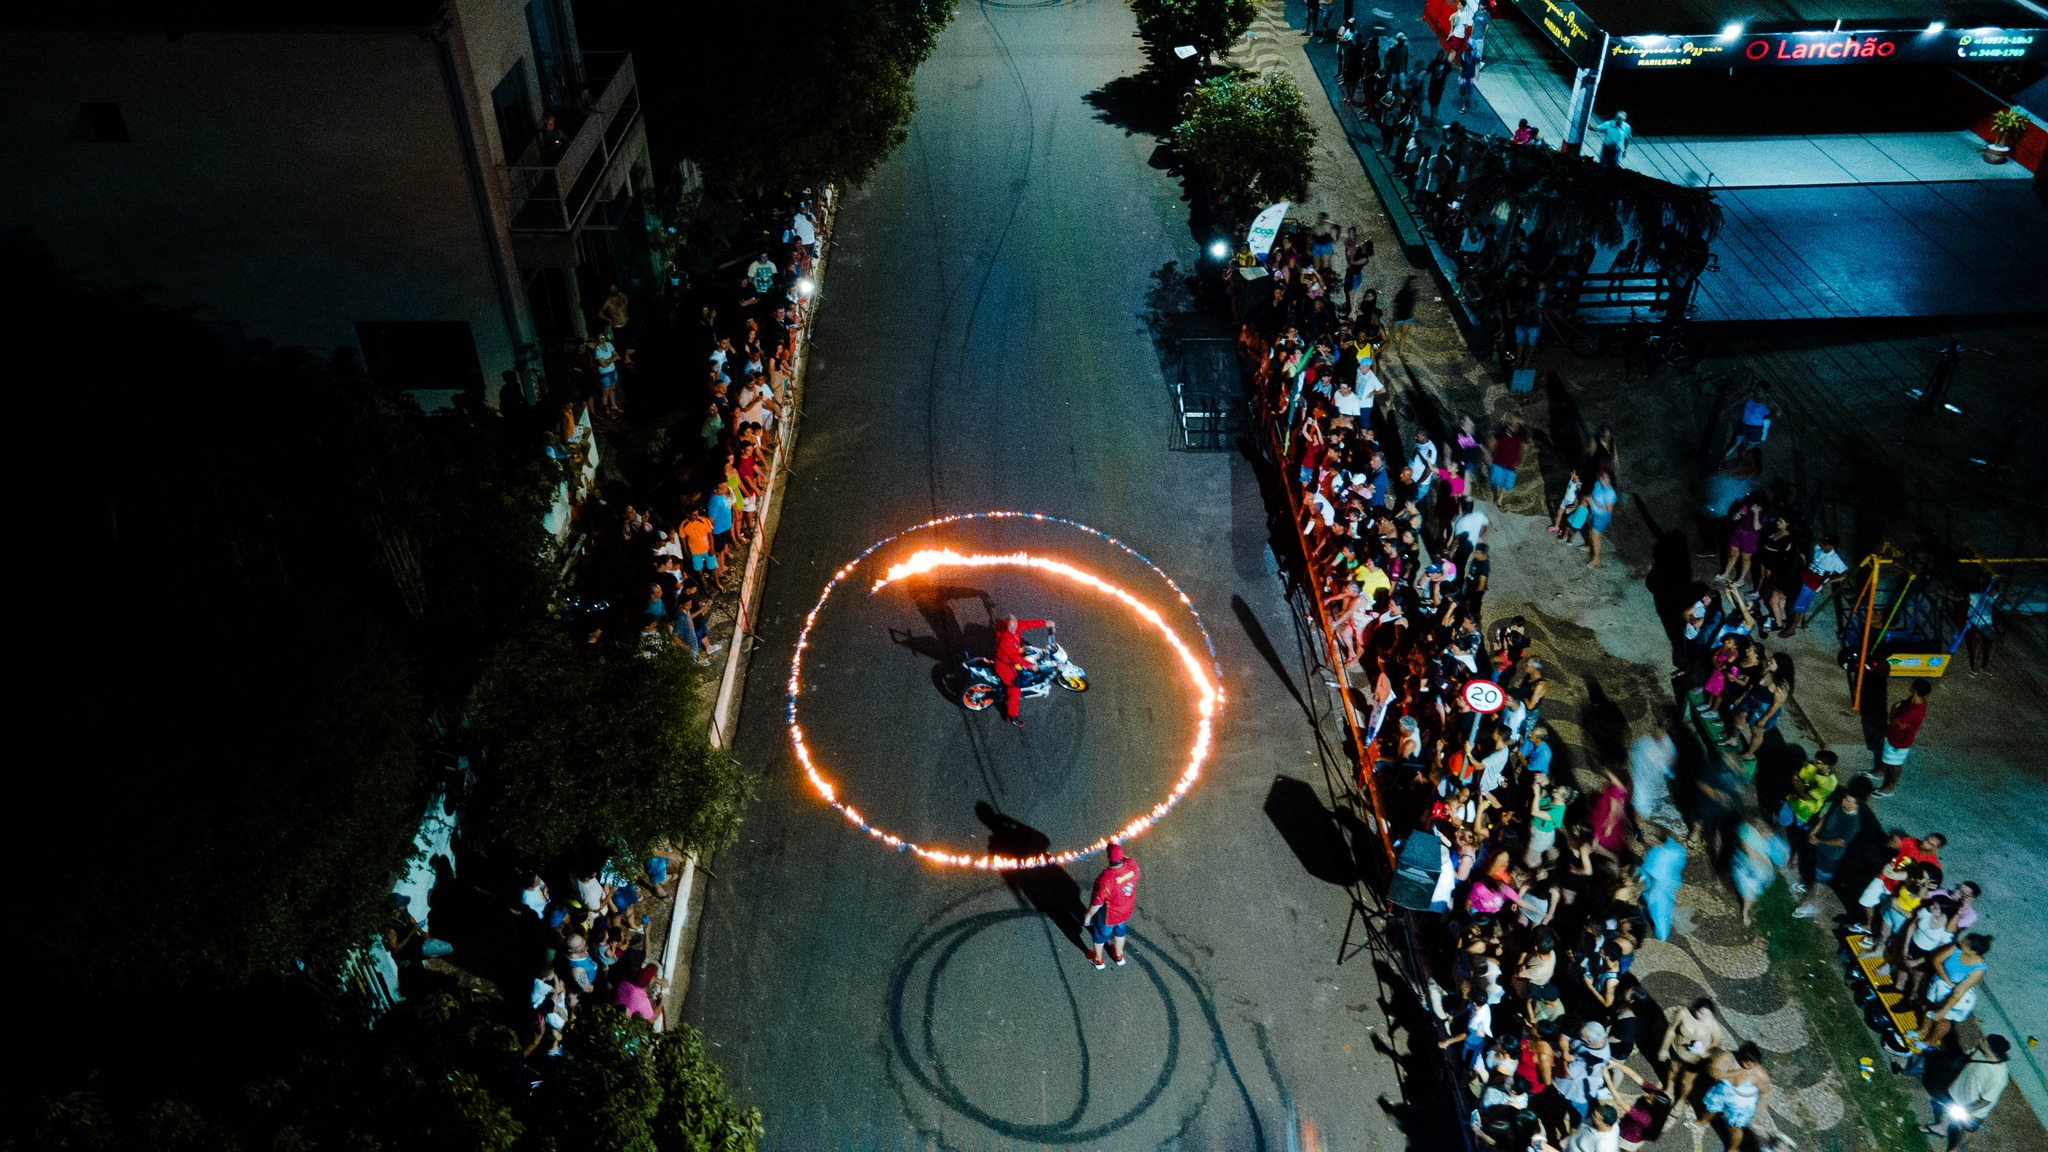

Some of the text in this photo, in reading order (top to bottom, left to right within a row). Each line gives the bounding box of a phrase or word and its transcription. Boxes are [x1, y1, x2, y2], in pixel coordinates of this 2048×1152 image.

[1746, 37, 1895, 60] O Lanchão
[1637, 58, 1692, 66] MARILENA-PR
[1471, 687, 1497, 703] 20
